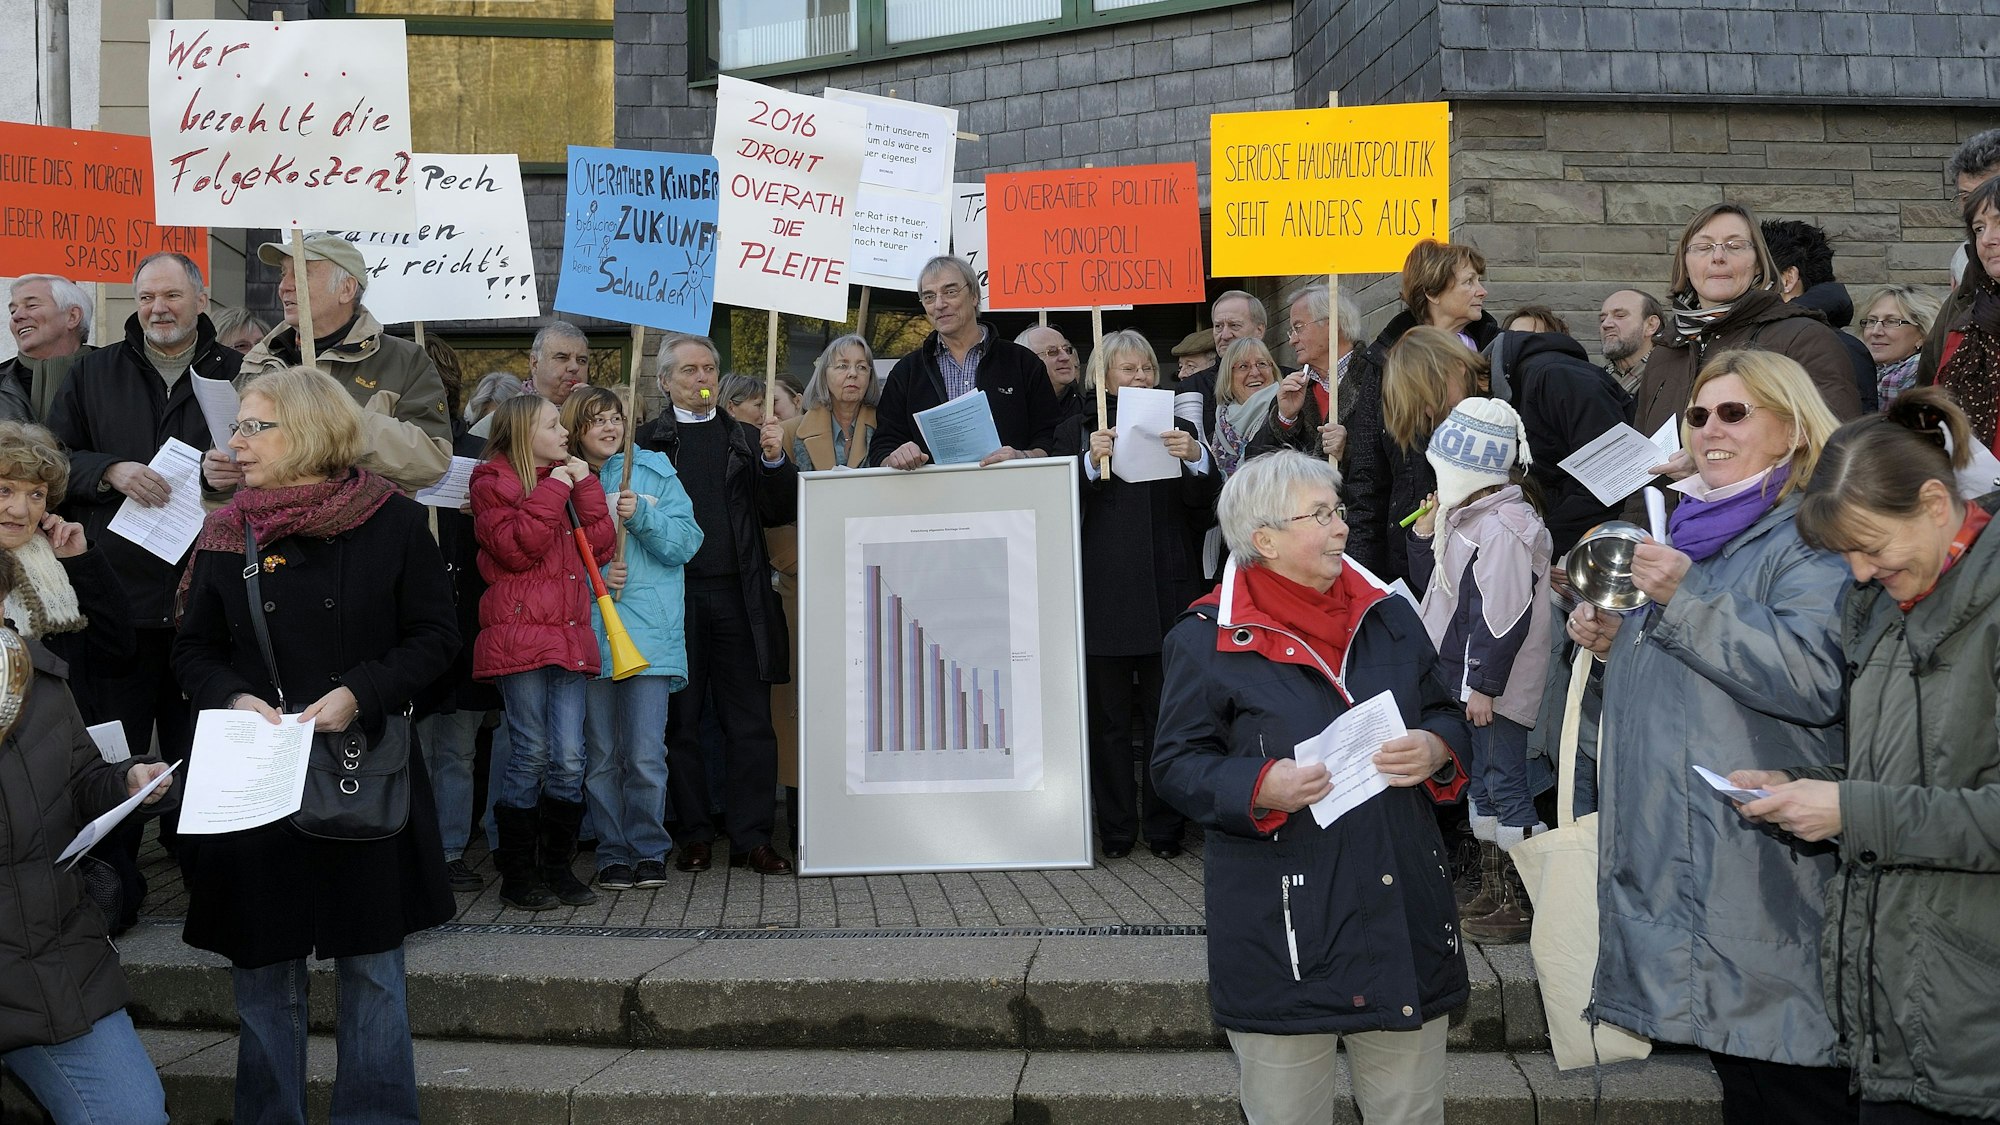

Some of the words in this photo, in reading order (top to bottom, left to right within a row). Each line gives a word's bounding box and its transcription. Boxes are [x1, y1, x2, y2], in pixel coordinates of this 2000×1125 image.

[168, 28, 250, 71] Wer
[180, 87, 316, 137] bezahlt
[332, 96, 391, 137] die
[748, 100, 817, 138] 2016
[874, 123, 890, 132] mit
[892, 127, 930, 140] unserem
[882, 138, 895, 147] als
[898, 142, 919, 151] wäre
[922, 146, 933, 154] es
[736, 138, 824, 173] DROHT
[881, 152, 917, 164] eigenes!
[1225, 143, 1291, 182] SERIÖSE
[1297, 140, 1436, 180] HAUSHALTSPOLITIK
[84, 163, 143, 197] MORGEN
[421, 164, 503, 192] Pech
[574, 156, 655, 197] OVERATHER
[731, 174, 845, 217] OVERATH
[52, 210, 80, 241] RAT
[86, 215, 116, 245] DAS
[127, 218, 154, 249] IST
[161, 226, 197, 254] KEIN
[769, 217, 805, 237] DIE
[867, 210, 883, 220] Rat
[886, 213, 898, 222] ist
[1226, 201, 1269, 237] SIEHT
[1281, 199, 1363, 237] ANDERS
[343, 223, 465, 247] annen
[855, 238, 876, 247] noch
[879, 240, 908, 251] teurer
[893, 227, 908, 238] Rat
[911, 231, 924, 240] ist
[1044, 225, 1138, 255] MONOPOLI
[402, 245, 510, 276] reicht's
[738, 241, 845, 285] PLEITE
[596, 256, 684, 307] Schulden
[1003, 261, 1069, 295] LÄSST
[1430, 423, 1509, 468] KÖLN
